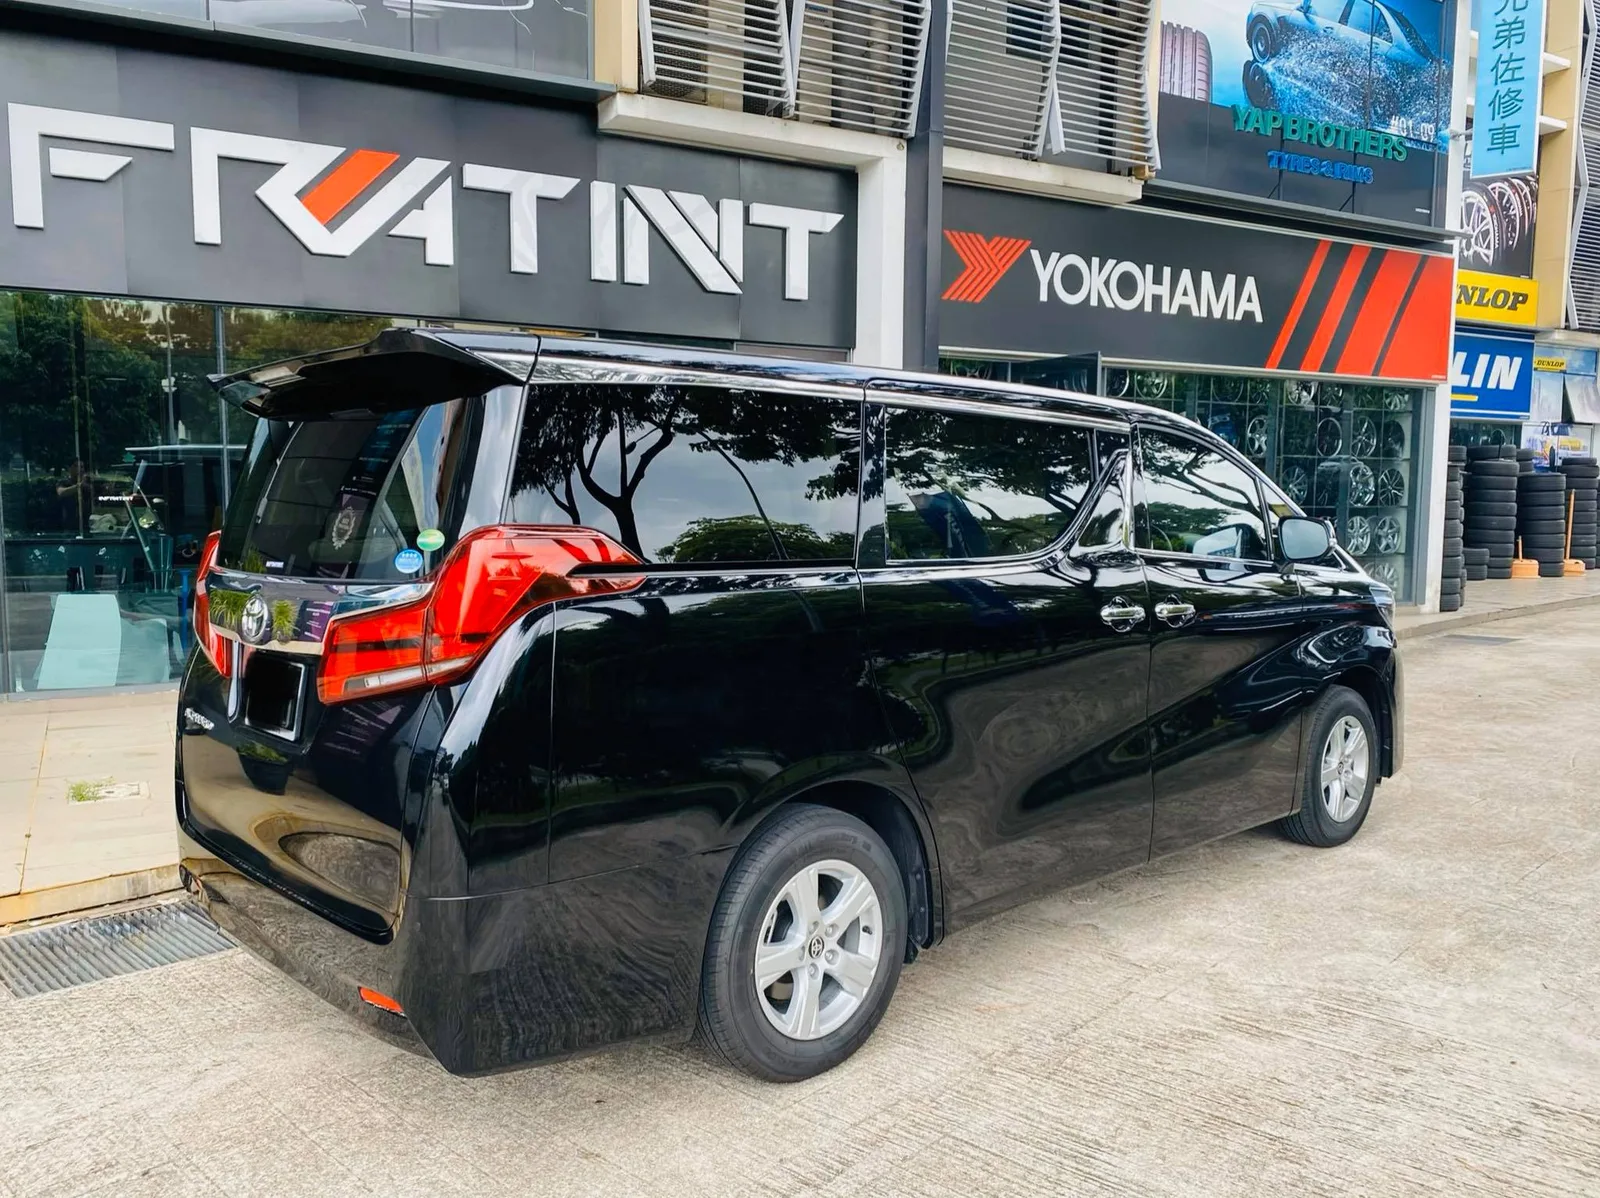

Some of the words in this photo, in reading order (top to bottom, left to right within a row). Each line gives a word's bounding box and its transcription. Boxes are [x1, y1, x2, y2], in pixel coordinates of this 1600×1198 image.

[1232, 104, 1283, 137] YAP
[1283, 113, 1408, 162] BROTHERS
[1267, 150, 1321, 176] TYRES
[8, 102, 844, 301] FRATINT
[1030, 248, 1263, 323] YOKOHAMA
[1456, 284, 1529, 311] NLOP
[1452, 351, 1523, 391] LIN
[1536, 359, 1565, 368] DUNLOP
